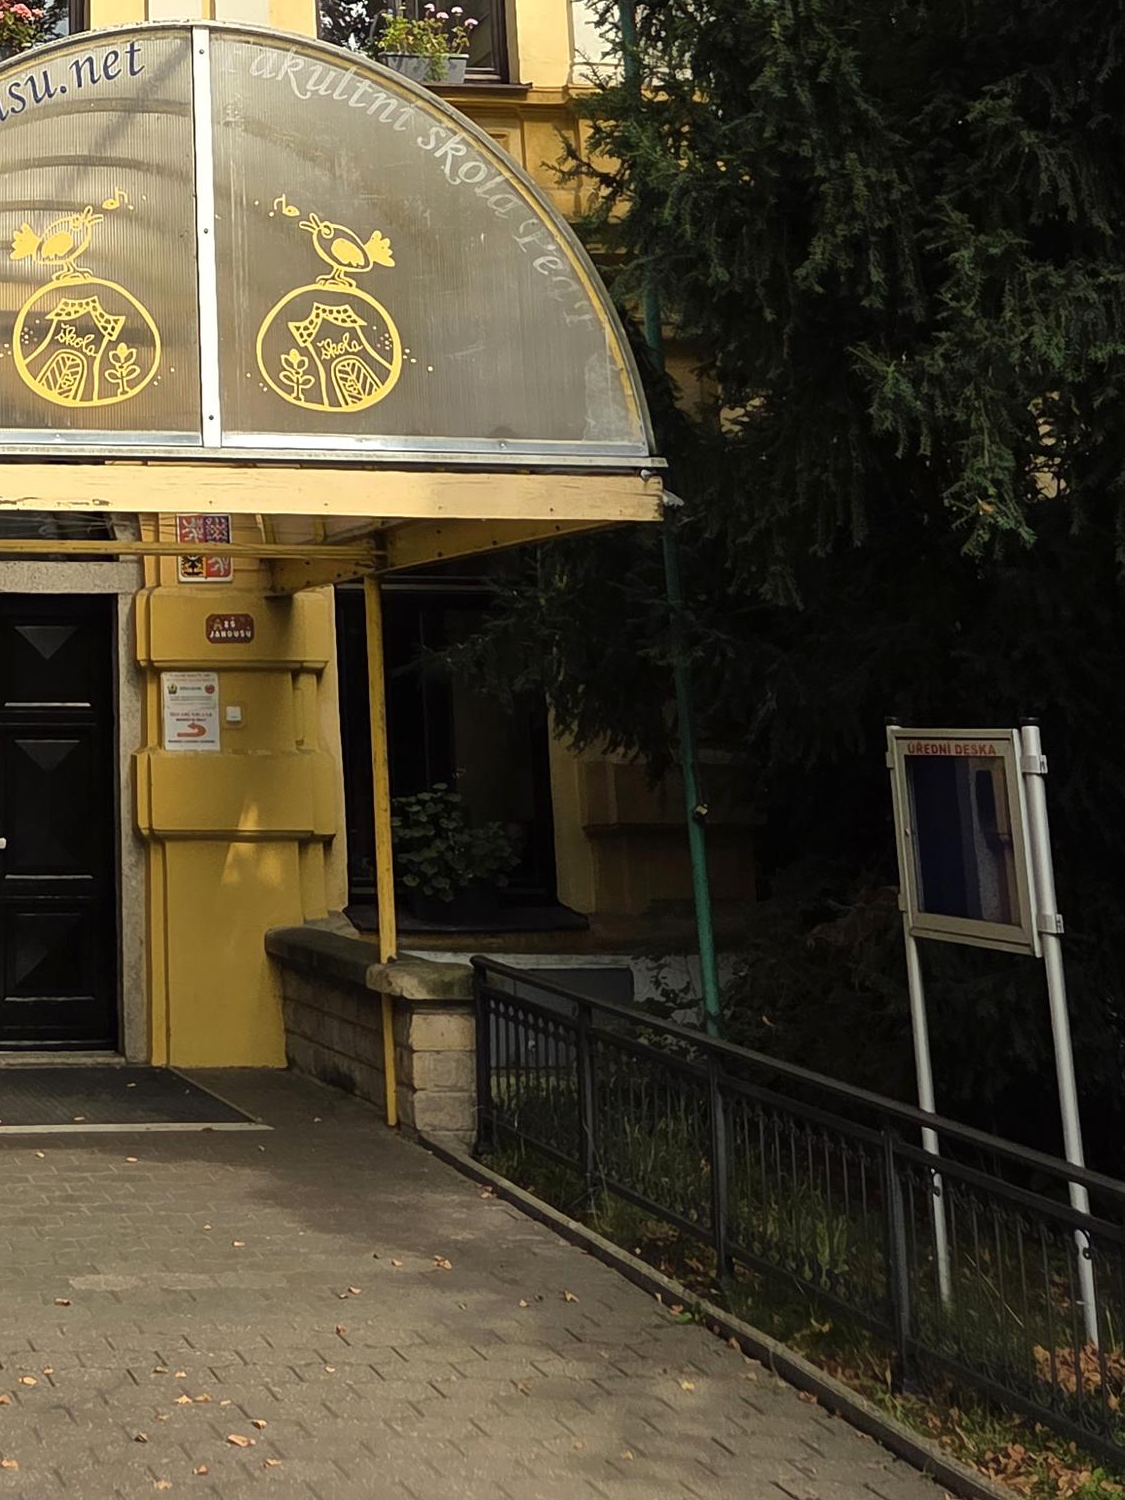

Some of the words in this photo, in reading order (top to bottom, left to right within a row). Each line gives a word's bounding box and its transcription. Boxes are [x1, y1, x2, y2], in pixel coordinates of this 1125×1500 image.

[220, 46, 416, 132] akultní
[53, 322, 99, 357] škola
[316, 331, 364, 362] škola
[954, 743, 996, 756] DESKA
